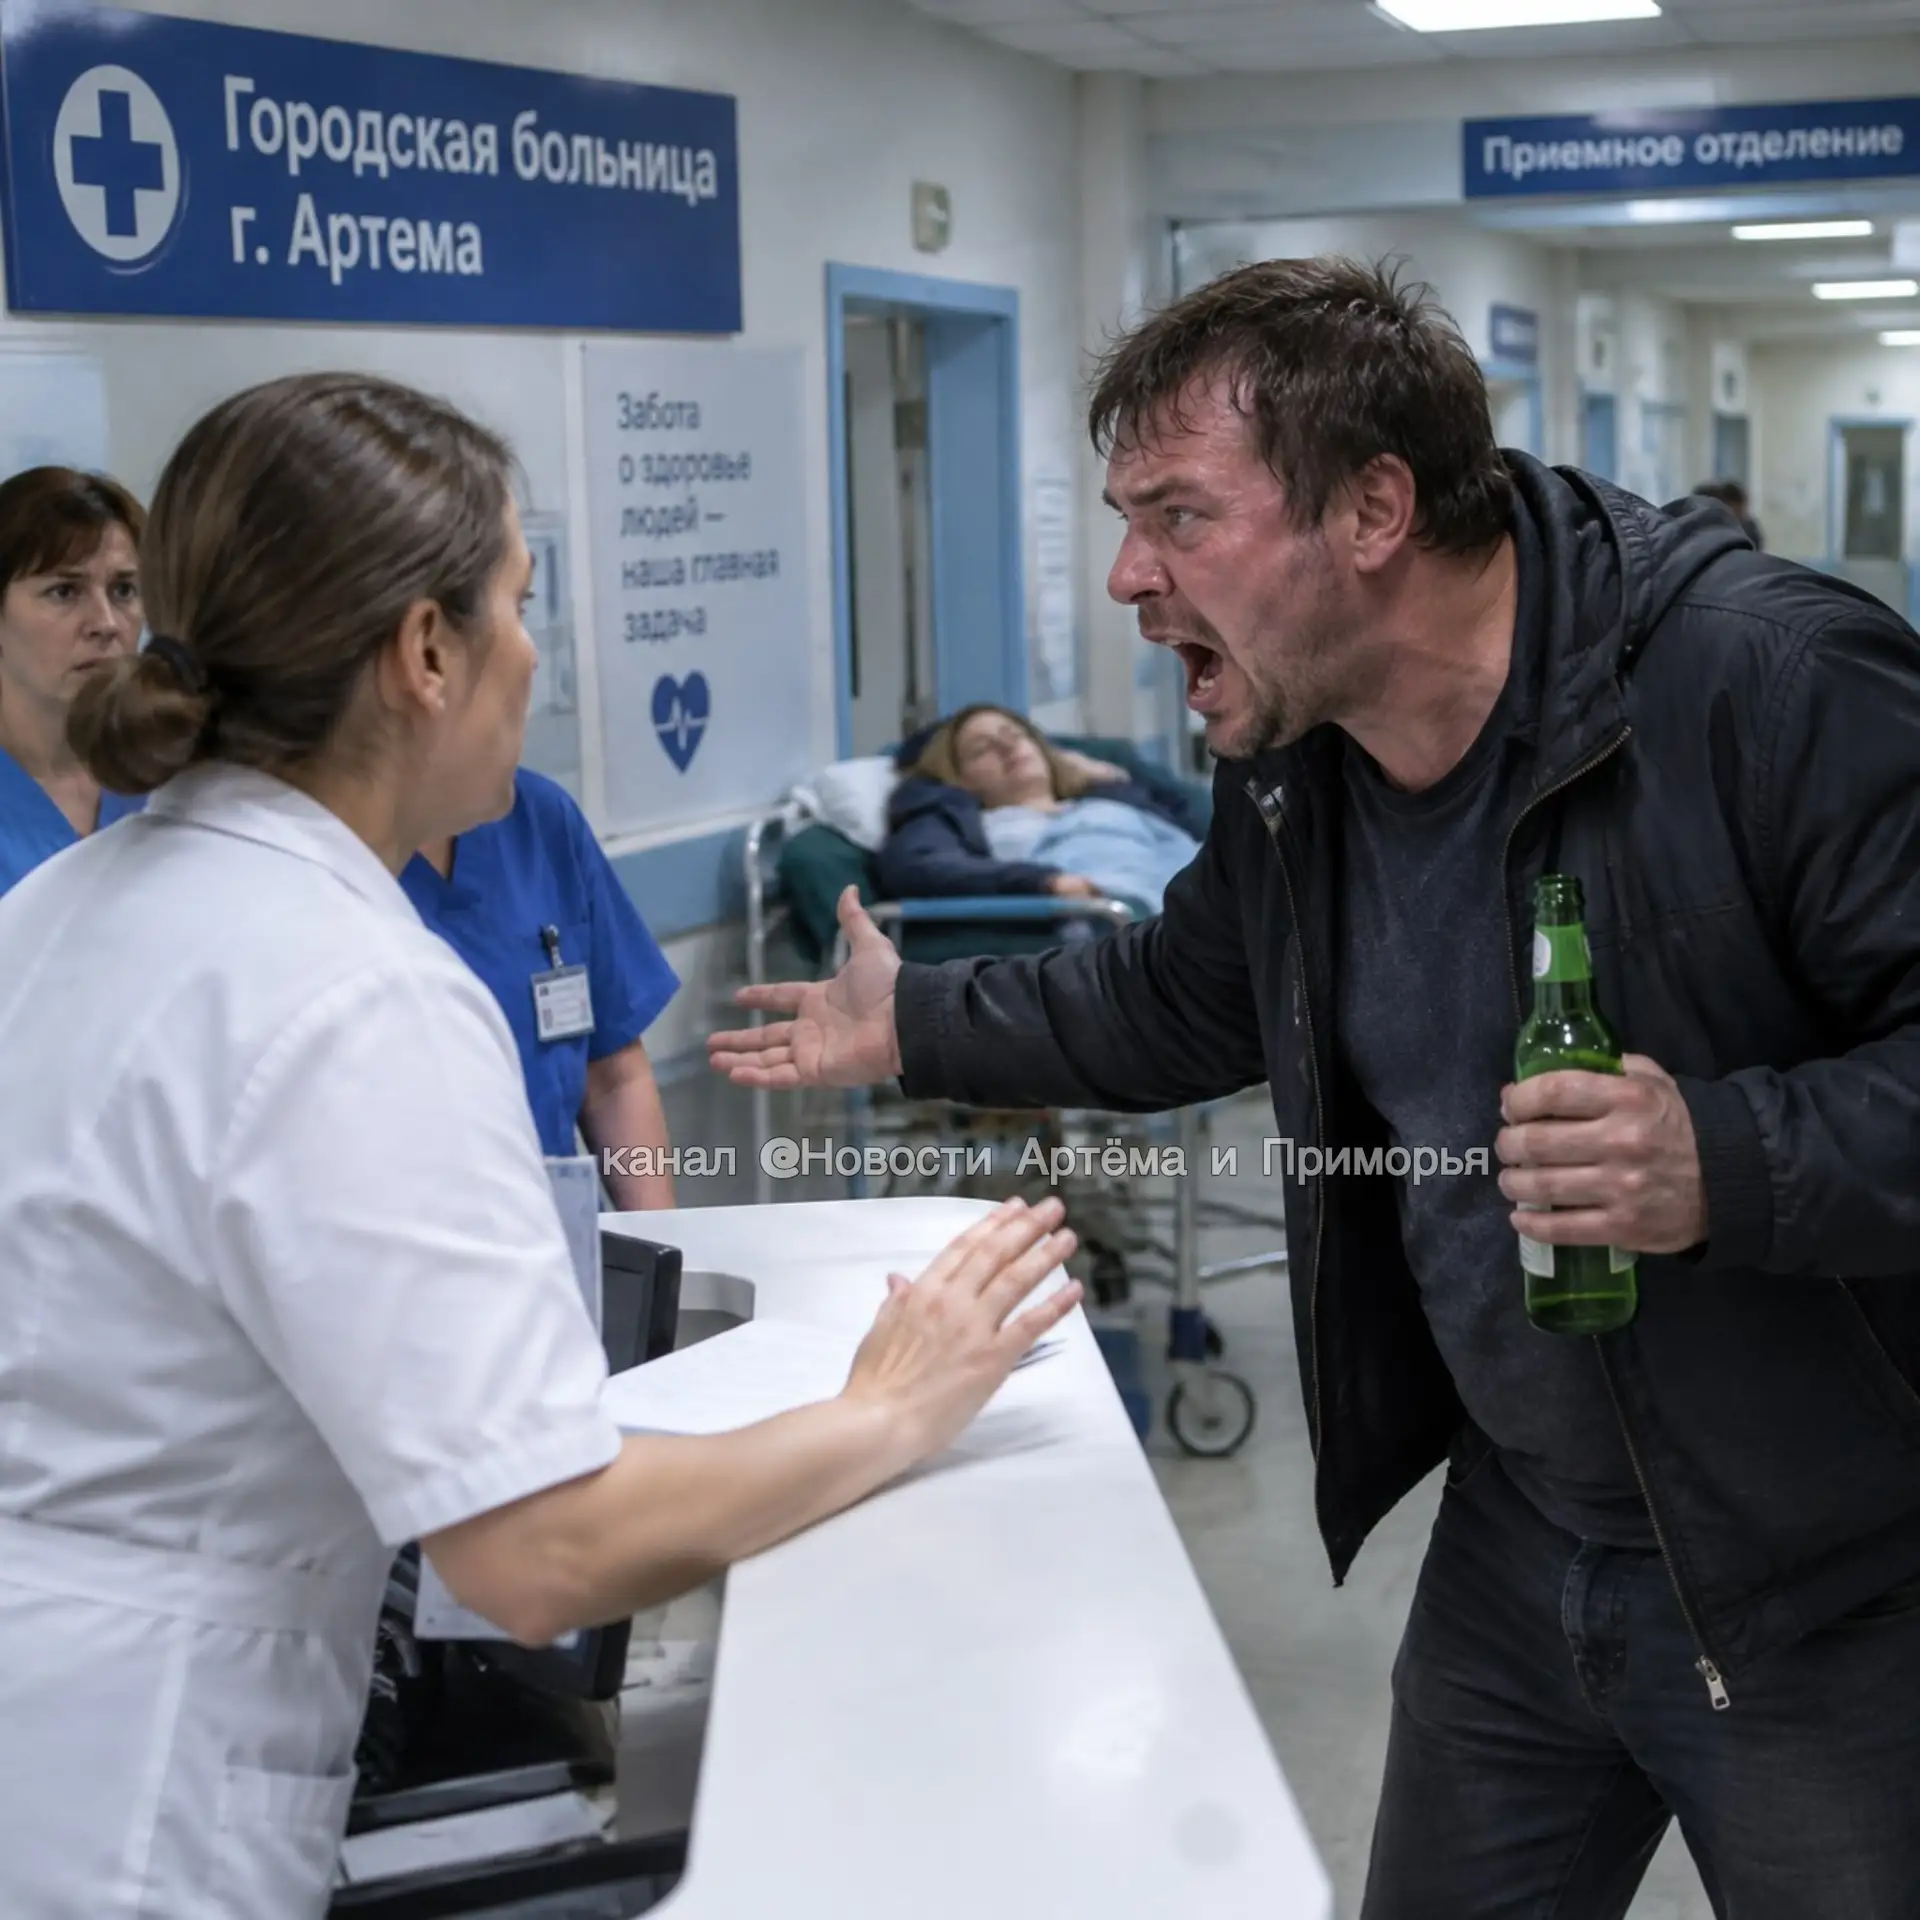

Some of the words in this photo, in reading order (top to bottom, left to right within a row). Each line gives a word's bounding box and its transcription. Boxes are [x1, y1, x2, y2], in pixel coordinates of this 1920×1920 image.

[223, 74, 499, 177] Городская
[511, 108, 717, 206] больница
[1483, 135, 1684, 179] Приемное
[1694, 124, 1903, 168] отделение
[230, 206, 269, 264] г.
[287, 194, 484, 285] Артема
[617, 391, 701, 431] Забота
[618, 453, 635, 485] о
[621, 496, 699, 539] людей
[622, 557, 685, 590] наша
[624, 607, 706, 644] задача
